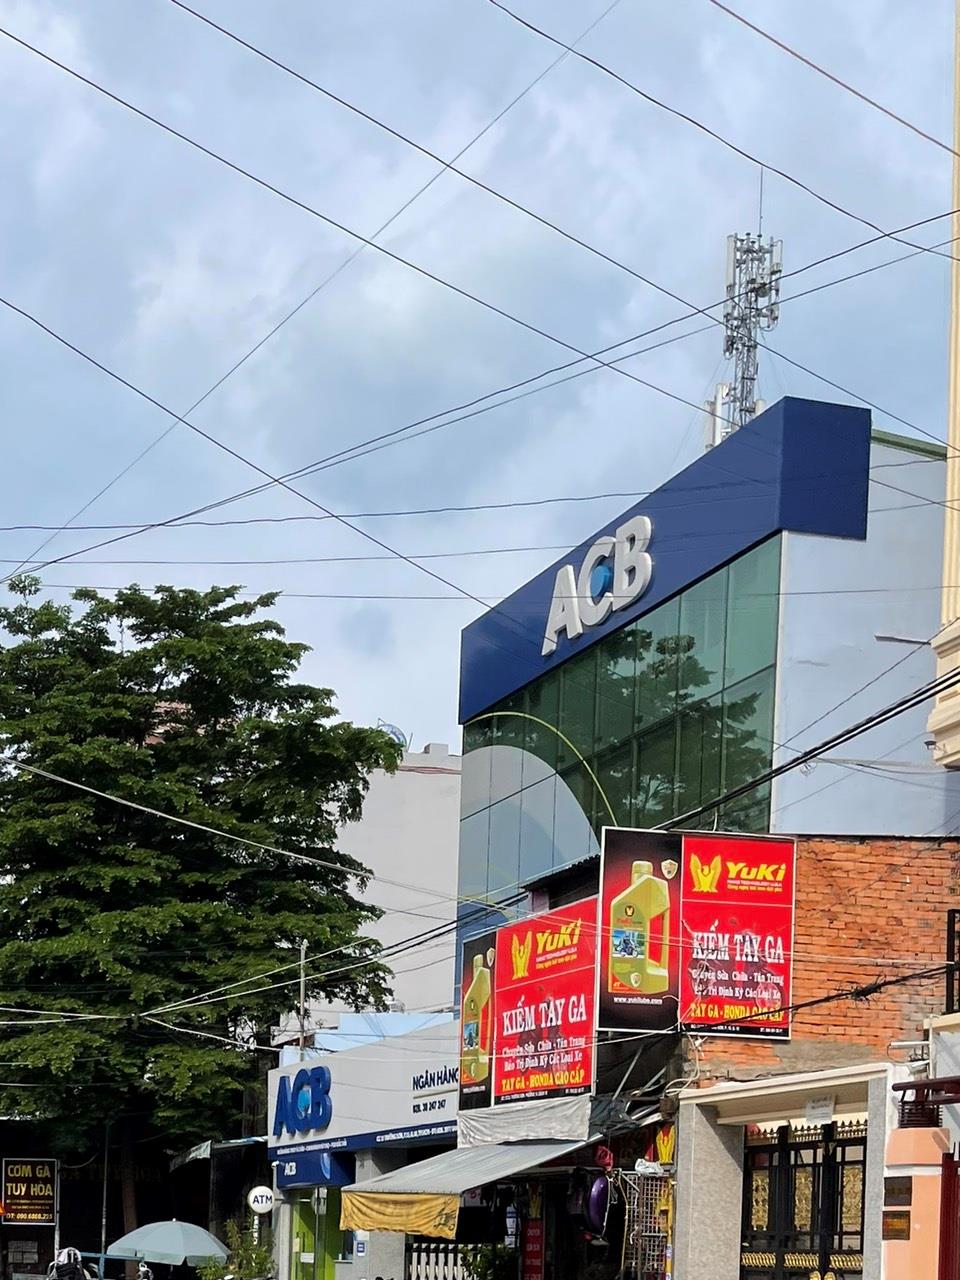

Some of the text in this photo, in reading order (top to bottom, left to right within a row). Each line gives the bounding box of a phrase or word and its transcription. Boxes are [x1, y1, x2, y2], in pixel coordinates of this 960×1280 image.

[542, 515, 652, 656] ACB
[733, 933, 761, 963] TAY
[764, 935, 785, 963] GA
[539, 998, 566, 1029] TAY
[568, 993, 587, 1025] GA
[708, 1004, 719, 1018] GA
[515, 1076, 526, 1090] GA
[273, 1065, 333, 1137] ACB
[284, 1161, 297, 1176] ACB
[6, 1182, 27, 1196] TUY
[252, 1194, 273, 1205] ATM
